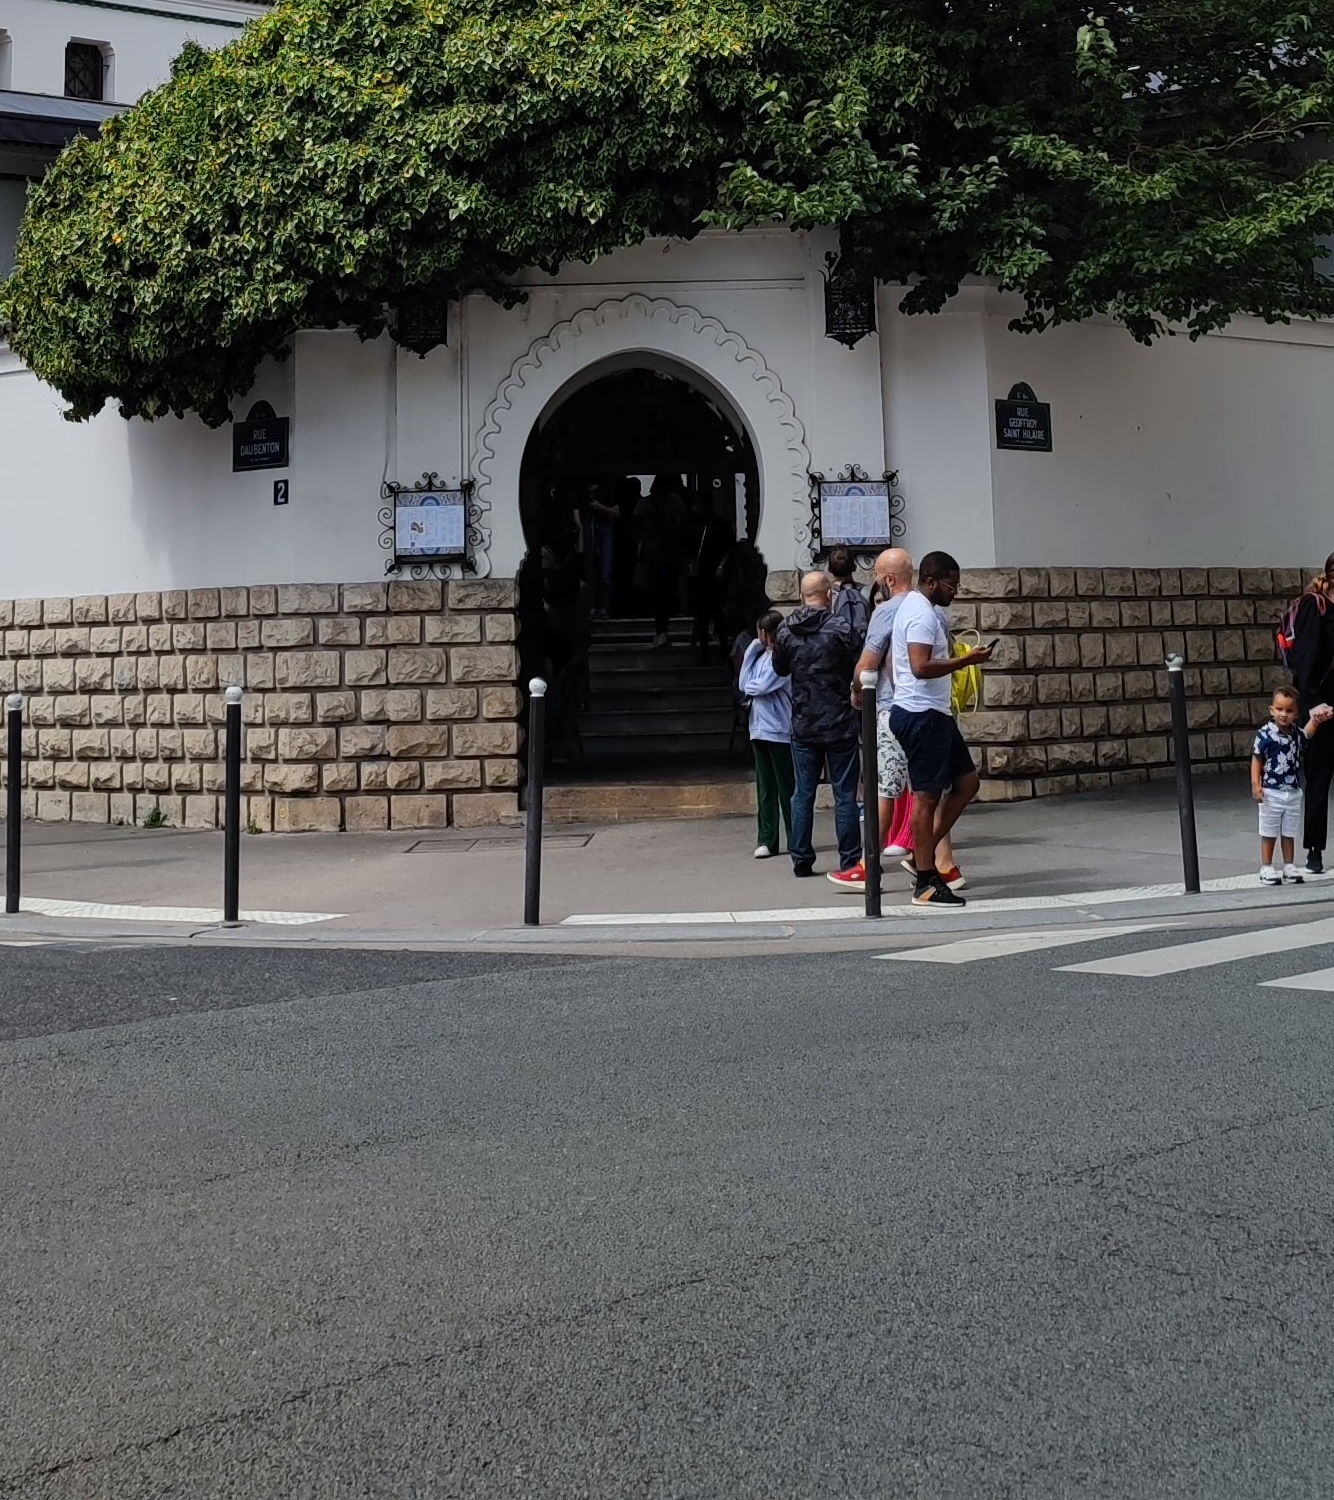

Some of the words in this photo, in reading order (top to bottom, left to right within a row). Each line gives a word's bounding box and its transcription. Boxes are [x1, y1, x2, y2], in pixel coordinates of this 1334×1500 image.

[1017, 407, 1029, 417] RUE
[253, 428, 267, 440] RUE
[1003, 428, 1020, 439] SAINT
[1022, 429, 1045, 440] HILAIRE
[240, 441, 280, 457] DAUBENTON
[277, 482, 286, 503] 2
